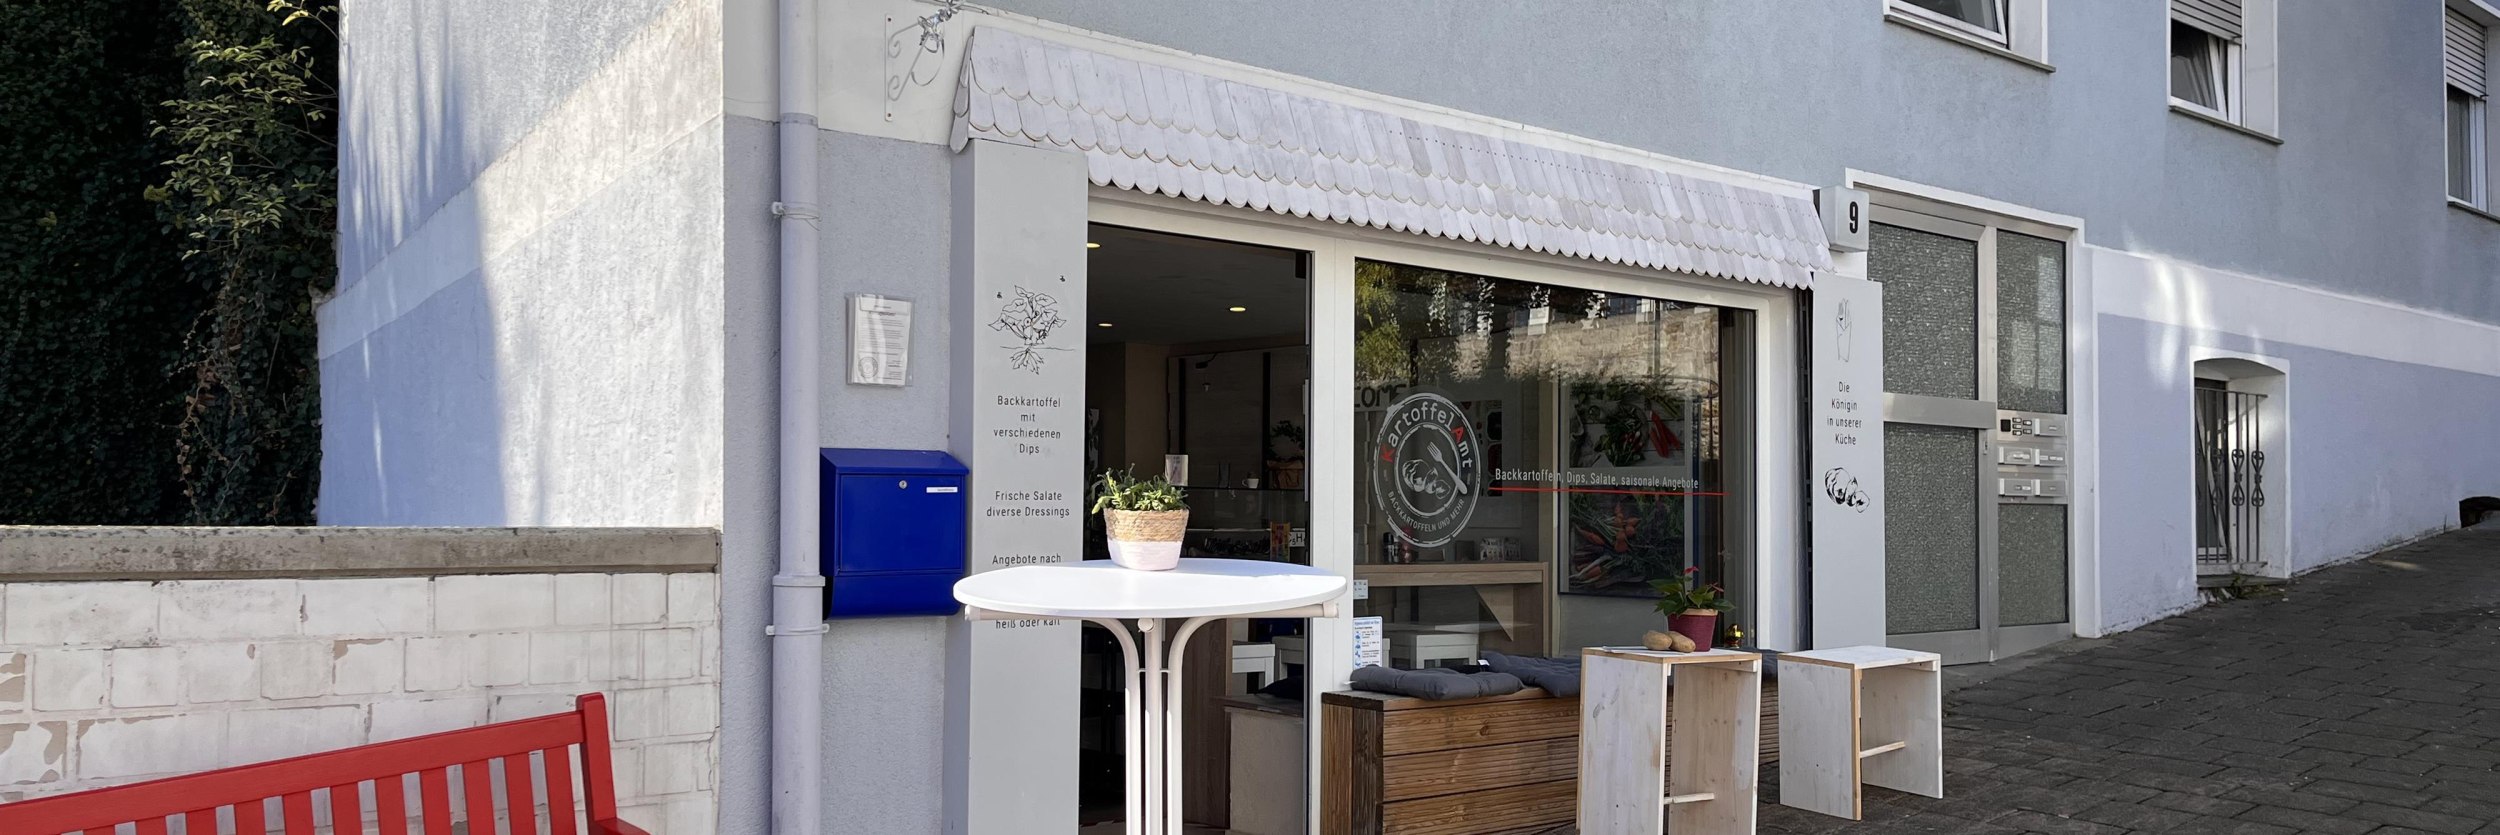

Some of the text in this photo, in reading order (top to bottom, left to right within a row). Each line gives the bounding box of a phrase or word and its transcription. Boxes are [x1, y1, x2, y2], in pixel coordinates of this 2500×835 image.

[1849, 201, 1859, 234] 9
[1838, 381, 1850, 393] Die
[997, 395, 1061, 408] Backkartoffel
[1831, 398, 1857, 413] Königin
[1020, 413, 1036, 422] mit
[1827, 416, 1862, 428] in unserer
[993, 427, 1061, 439] verschiedenen
[1835, 433, 1857, 446] Küche
[1019, 443, 1040, 455] Dips
[1566, 471, 1588, 484] Dips,
[1590, 472, 1619, 486] Salate,
[1621, 475, 1660, 487] saisonale
[1662, 476, 1699, 490] Angebote
[995, 490, 1063, 501] Frische Salate
[986, 506, 1070, 519] diverse Dressings
[1437, 517, 1451, 530] UND
[1450, 499, 1465, 519] MEHR
[992, 553, 1062, 567] Angebote nach
[1019, 619, 1040, 628] oder
